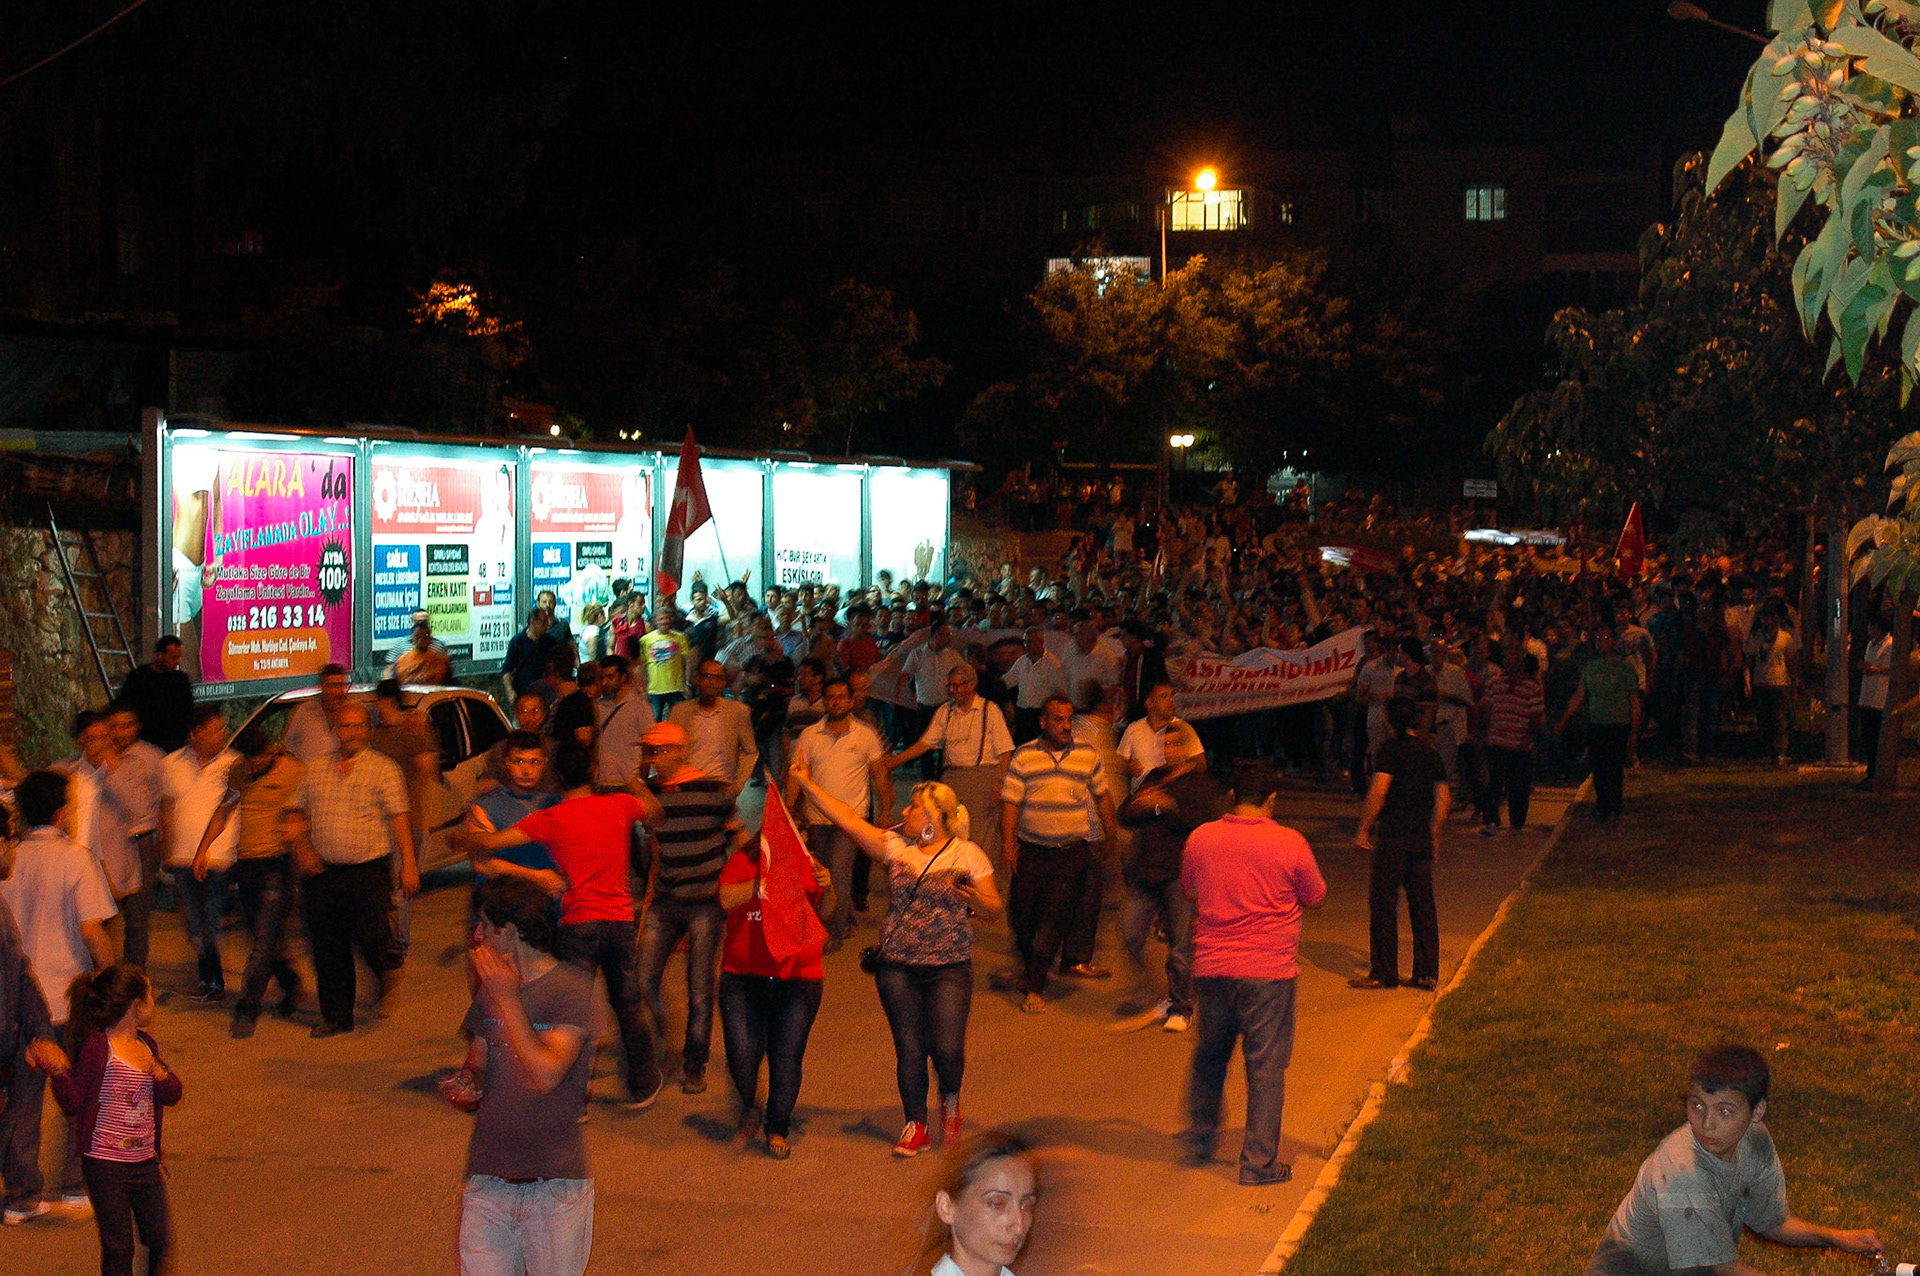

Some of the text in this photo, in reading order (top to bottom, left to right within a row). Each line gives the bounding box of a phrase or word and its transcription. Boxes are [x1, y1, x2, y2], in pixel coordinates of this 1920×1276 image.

[226, 458, 305, 498] ALARA
[322, 551, 344, 566] AYDA
[217, 562, 311, 580] Mutlaka Size Göre de Bir
[478, 562, 487, 579] 48
[497, 562, 506, 577] 72
[427, 581, 467, 598] ERKEN KAYIT
[375, 590, 404, 609] OKUMAK
[249, 605, 277, 630] 216
[282, 604, 303, 629] 33
[307, 603, 326, 628] 14
[479, 621, 511, 638] 444 23 18
